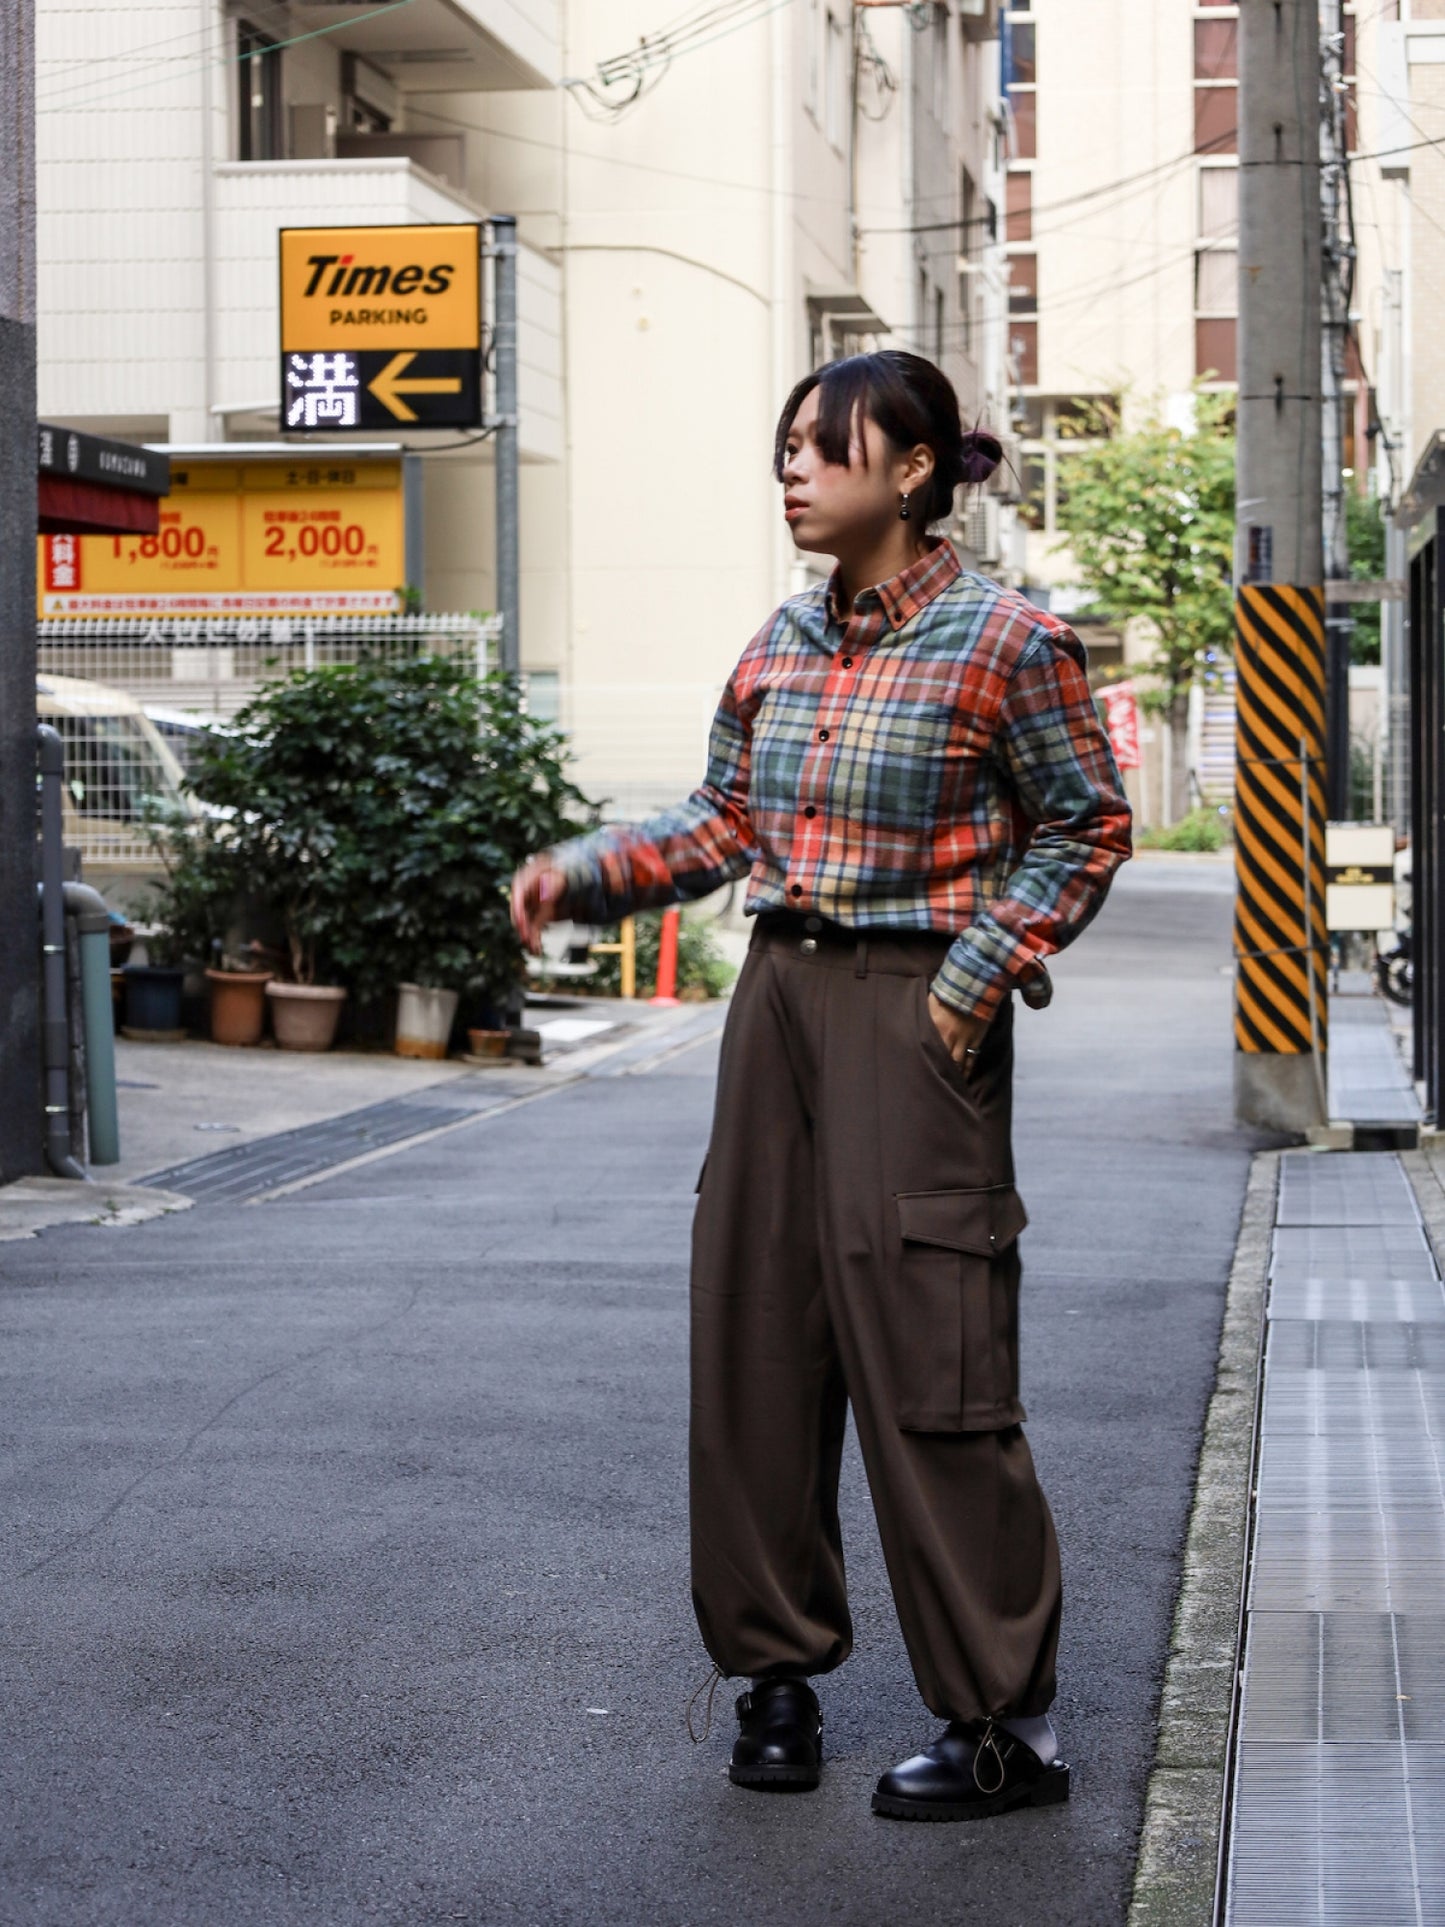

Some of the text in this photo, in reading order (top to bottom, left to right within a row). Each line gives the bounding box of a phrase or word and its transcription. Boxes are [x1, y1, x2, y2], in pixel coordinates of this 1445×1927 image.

[304, 255, 455, 298] Times
[330, 309, 428, 325] PARKING
[287, 353, 360, 426] 満
